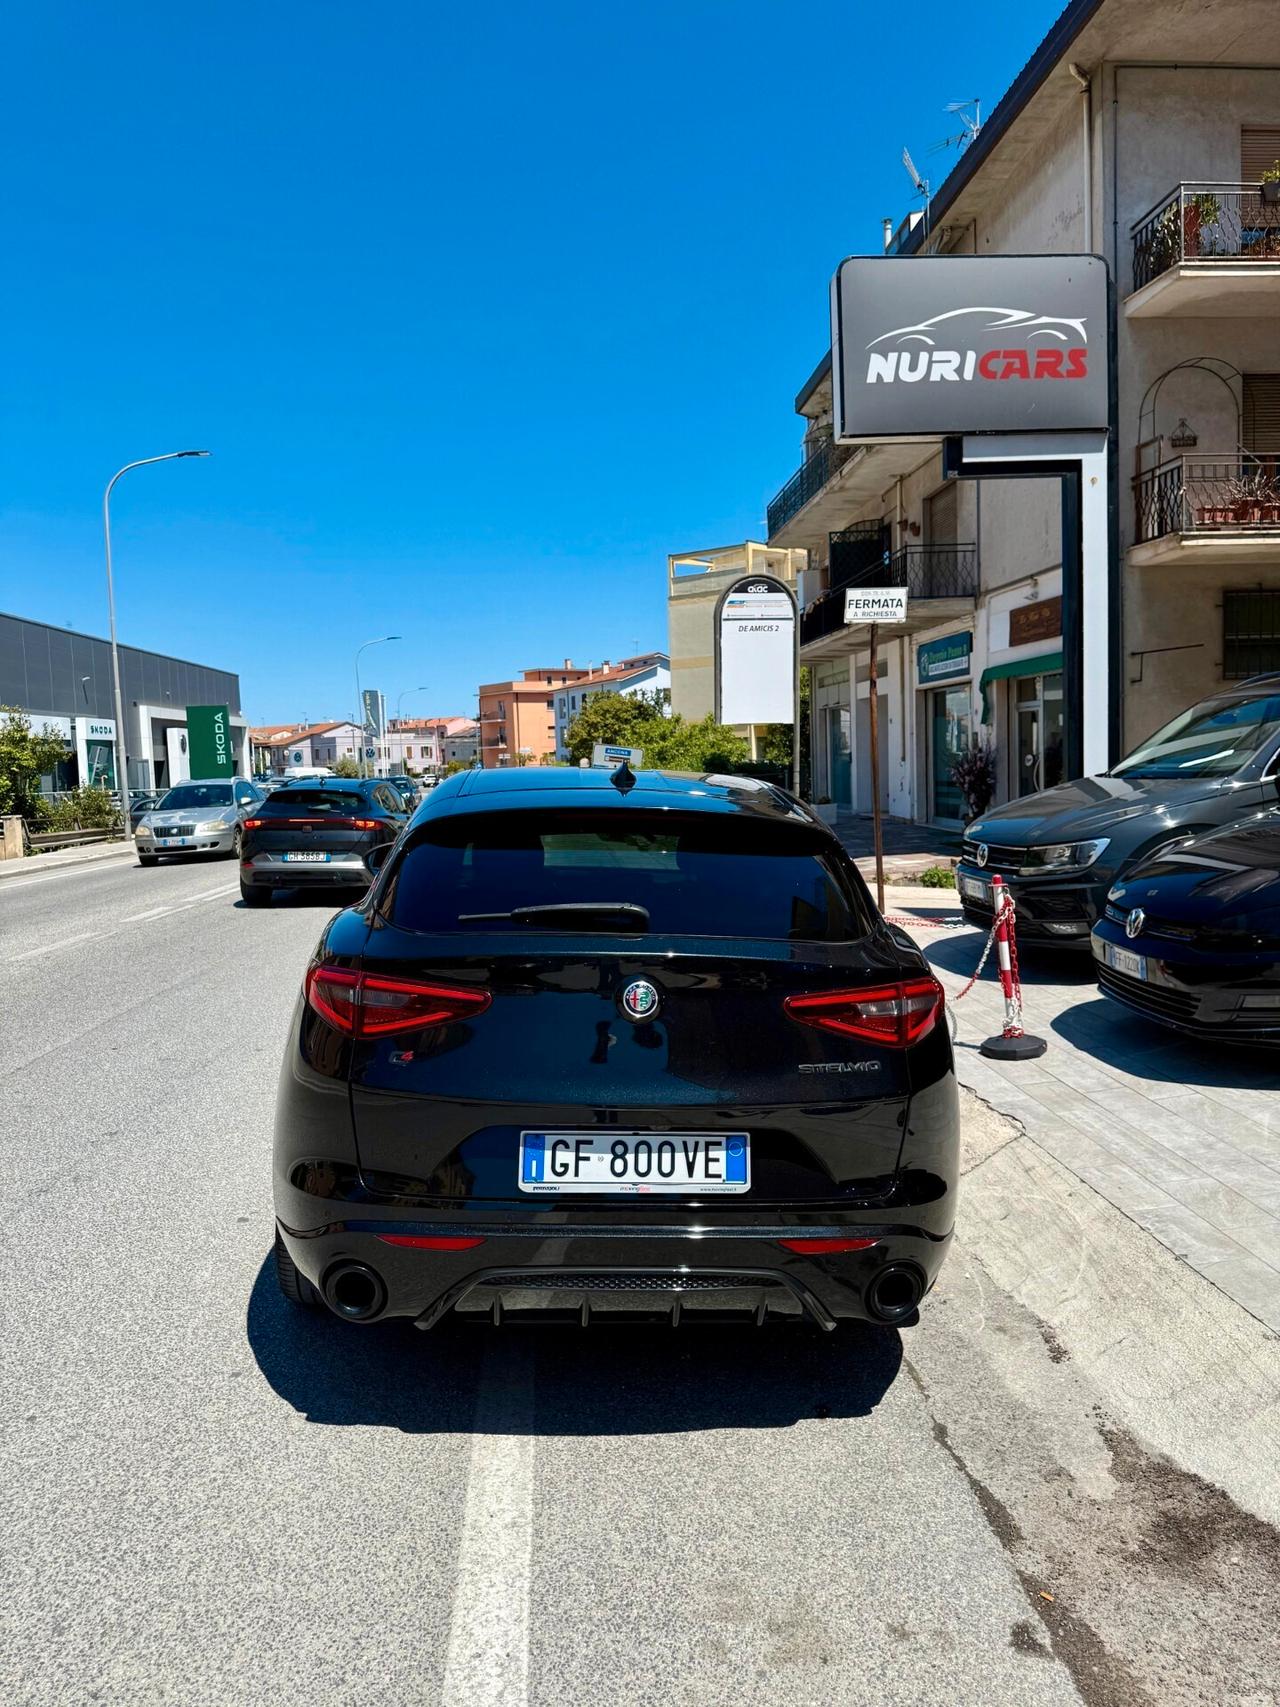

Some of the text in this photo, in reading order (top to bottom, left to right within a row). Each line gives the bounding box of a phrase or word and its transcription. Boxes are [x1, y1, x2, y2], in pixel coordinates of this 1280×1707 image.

[866, 349, 1088, 383] NURICARS
[848, 598, 903, 608] FERMATA
[798, 1060, 881, 1073] STELVIO
[551, 1139, 594, 1178] GF
[610, 1139, 723, 1178] 800VE
